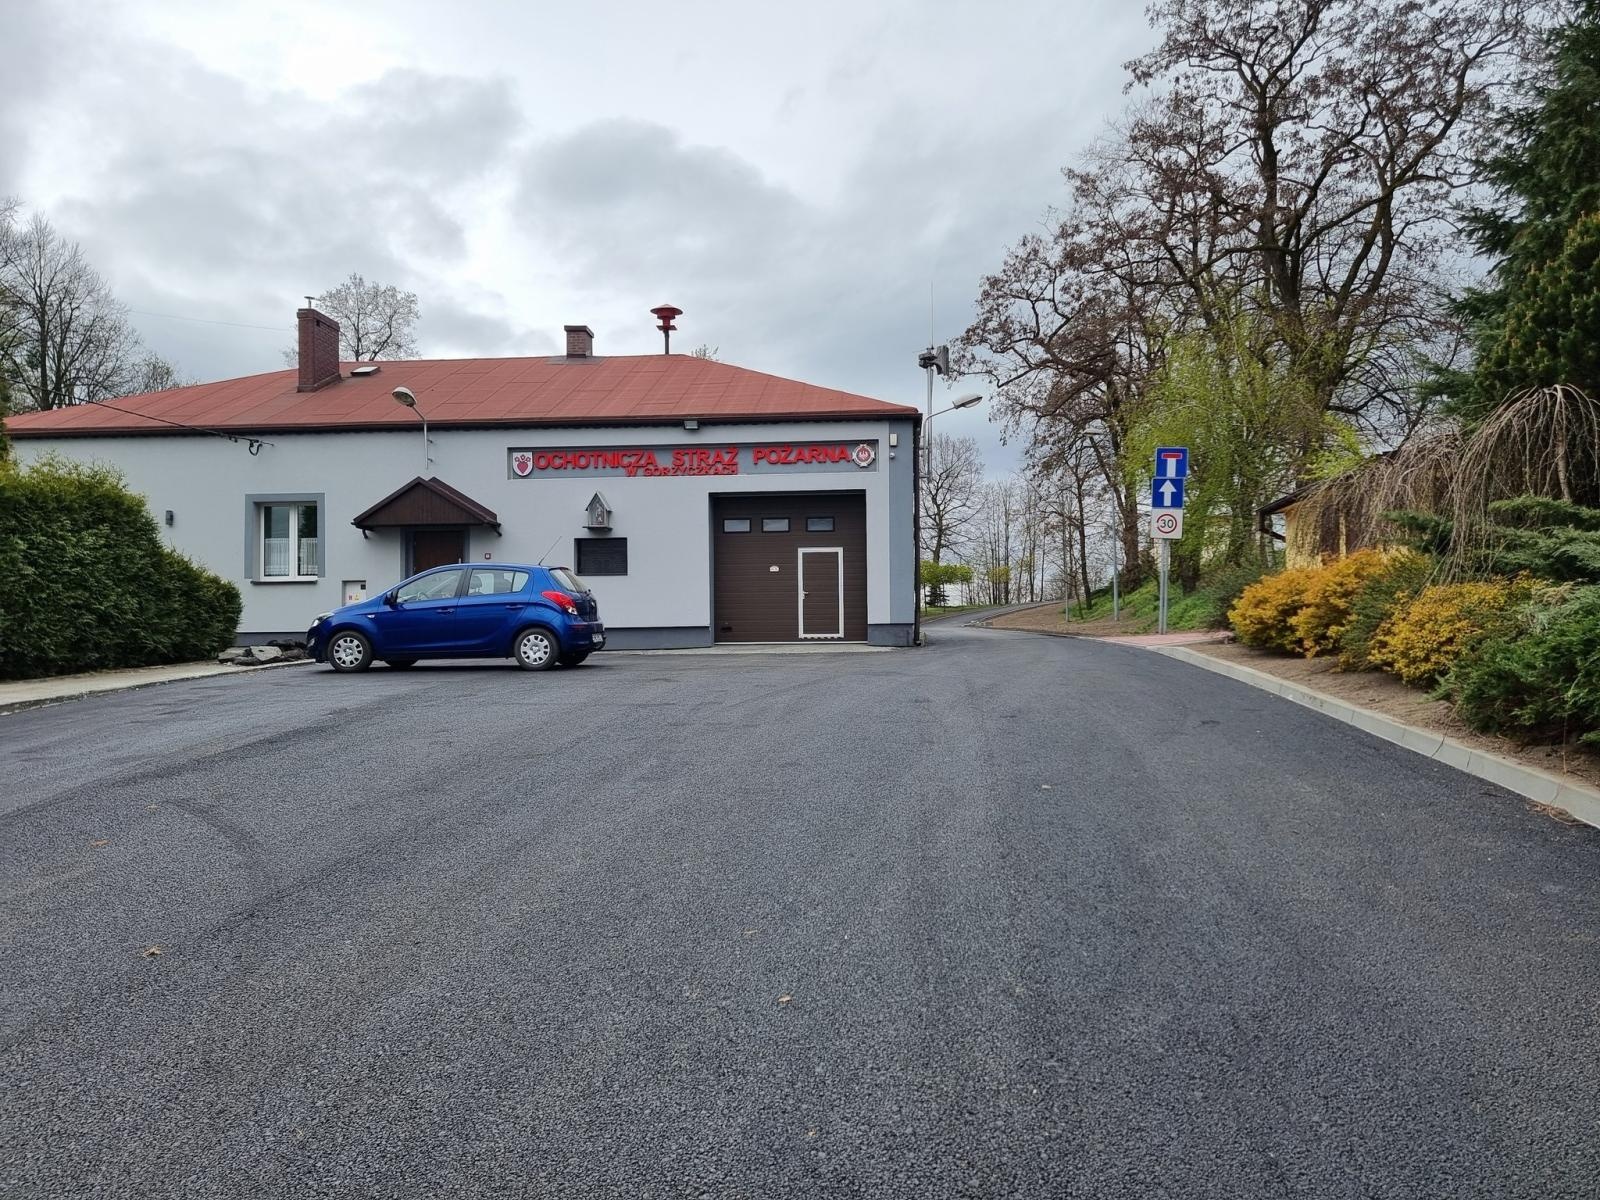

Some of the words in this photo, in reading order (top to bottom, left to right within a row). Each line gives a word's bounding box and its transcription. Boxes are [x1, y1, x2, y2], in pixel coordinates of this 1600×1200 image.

[534, 450, 658, 469] OCHOTNICZA
[754, 444, 851, 464] POŻARNA
[625, 465, 637, 477] W
[1160, 518, 1174, 529] 30
